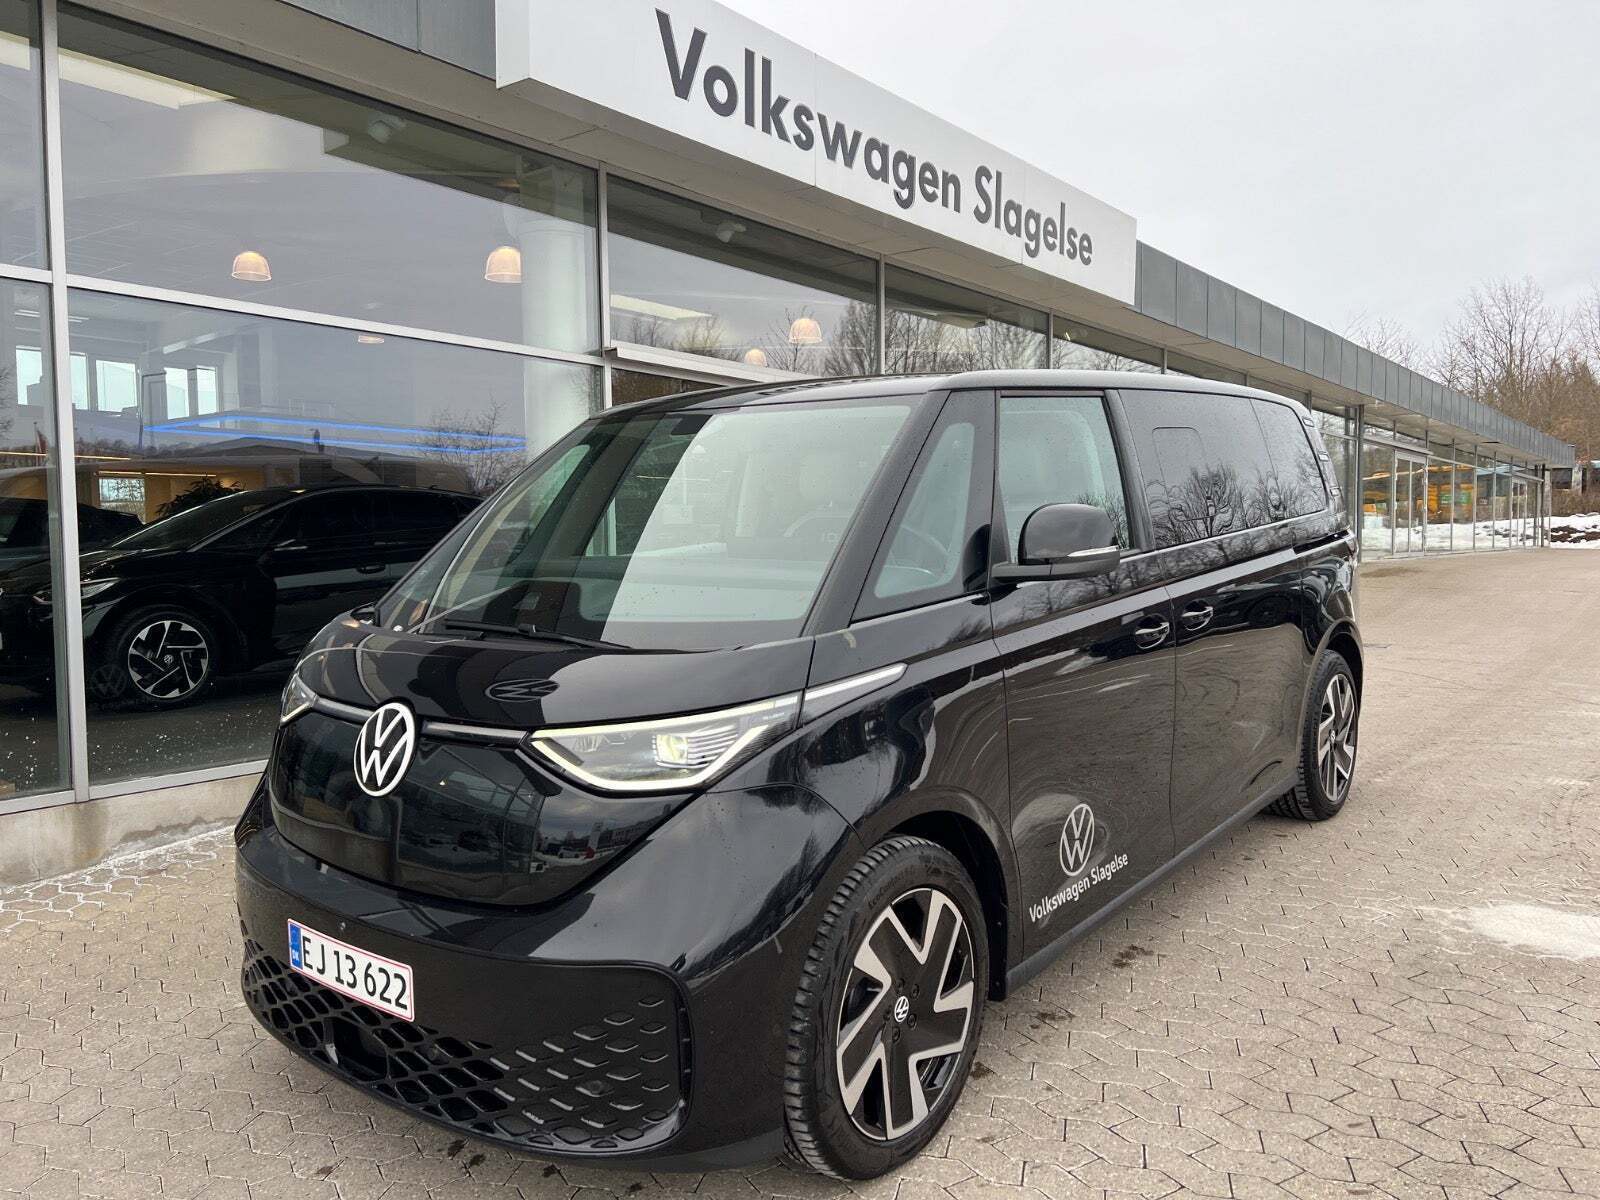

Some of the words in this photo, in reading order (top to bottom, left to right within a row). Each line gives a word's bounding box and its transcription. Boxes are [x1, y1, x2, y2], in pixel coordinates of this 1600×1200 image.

[655, 8, 961, 213] Volkswagen
[973, 165, 1093, 266] Slagelse
[354, 703, 415, 796] VW
[1060, 803, 1094, 876] VW
[1029, 877, 1090, 923] Volkswagen
[1090, 853, 1128, 885] Slagelse
[302, 935, 326, 975] EJ
[333, 950, 358, 989] 13
[363, 961, 408, 1010] 622
